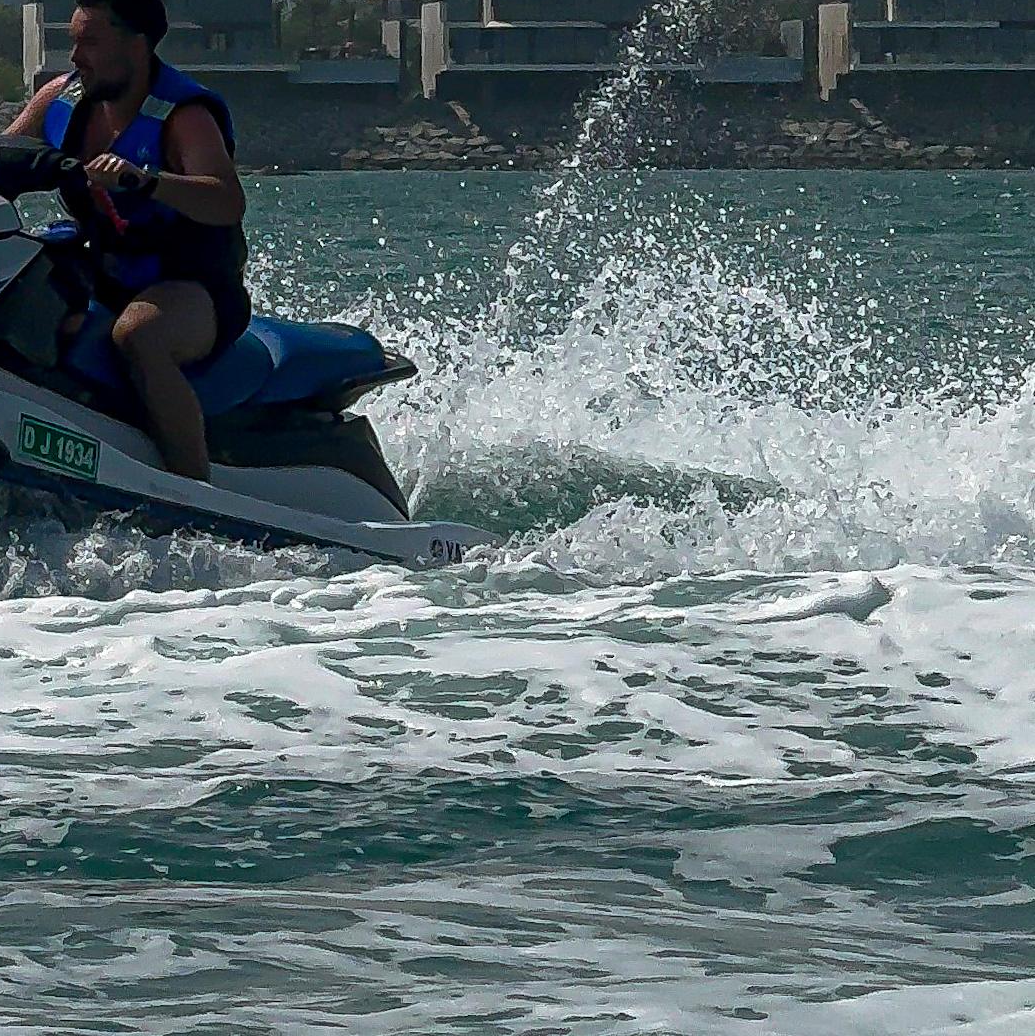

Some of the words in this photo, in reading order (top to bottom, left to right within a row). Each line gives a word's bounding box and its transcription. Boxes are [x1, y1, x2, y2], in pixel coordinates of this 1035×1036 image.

[24, 425, 35, 449] D
[40, 432, 51, 455] J
[56, 437, 94, 469] 1934
